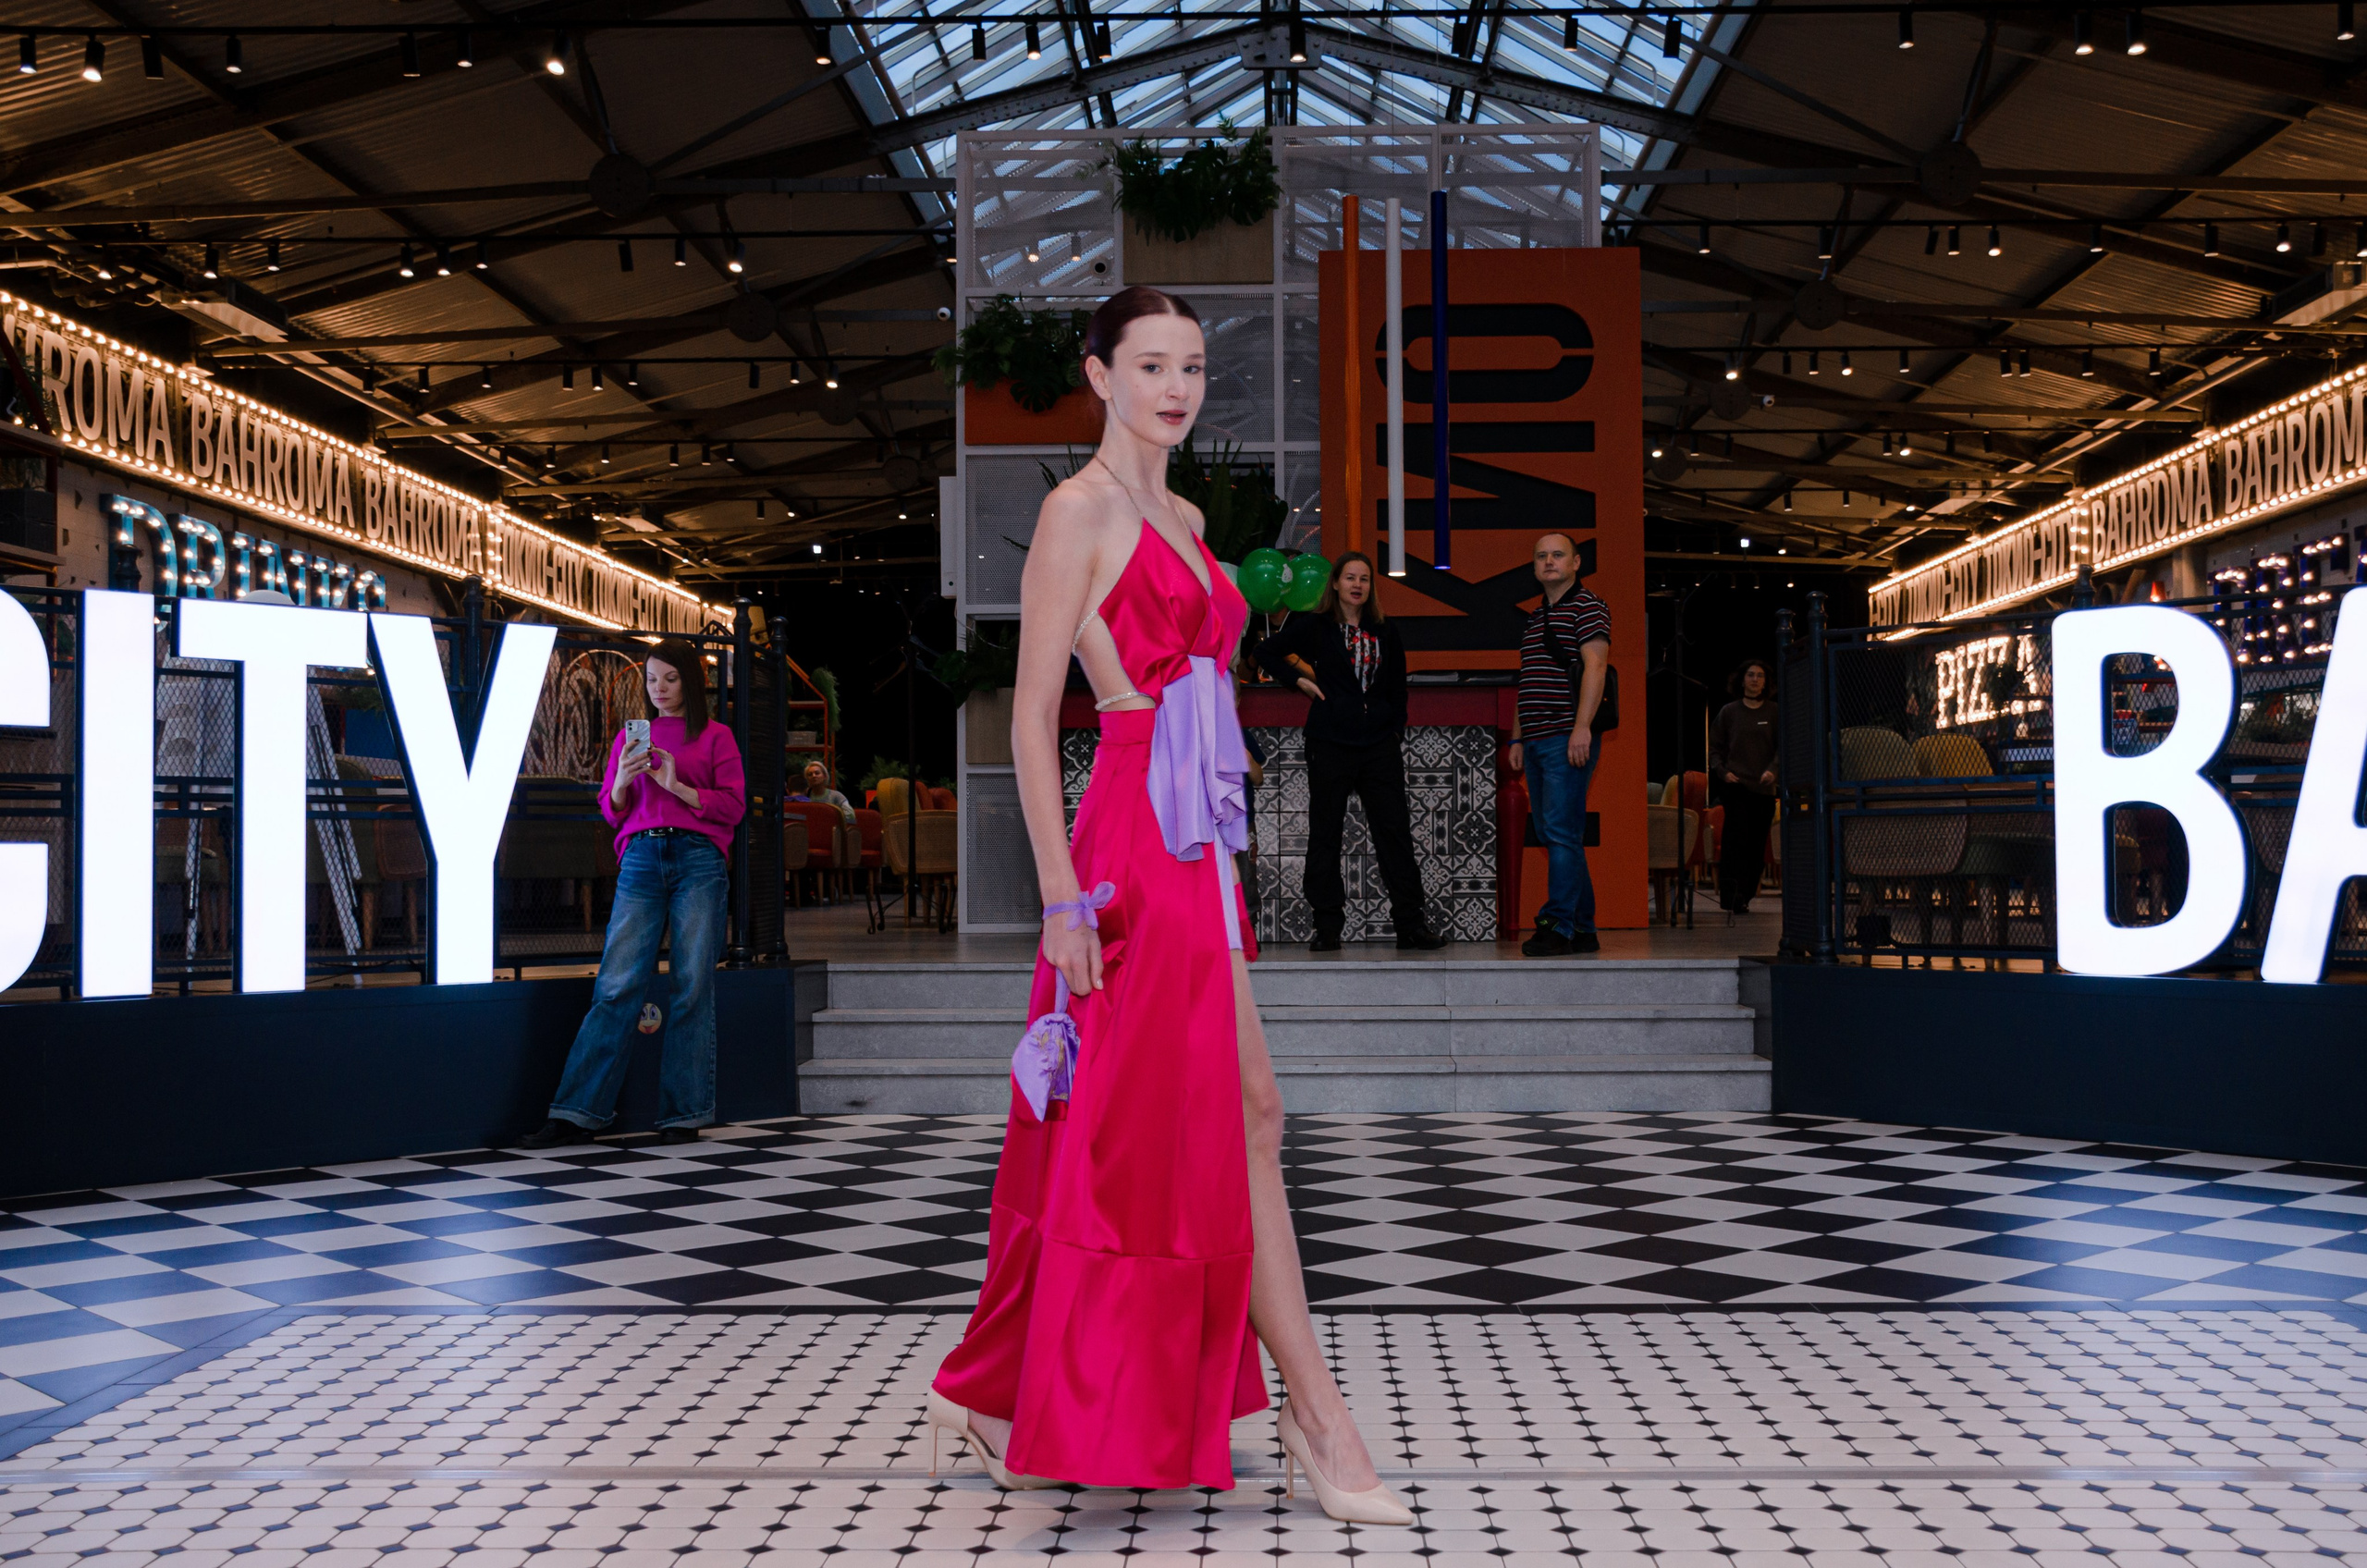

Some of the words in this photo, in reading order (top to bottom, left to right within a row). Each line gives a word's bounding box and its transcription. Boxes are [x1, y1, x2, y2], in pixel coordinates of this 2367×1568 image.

[191, 392, 355, 529] BAHROMA
[365, 468, 484, 574] BAHROMA
[2091, 452, 2214, 564] BAHROMA
[2224, 386, 2367, 514] BAHROM
